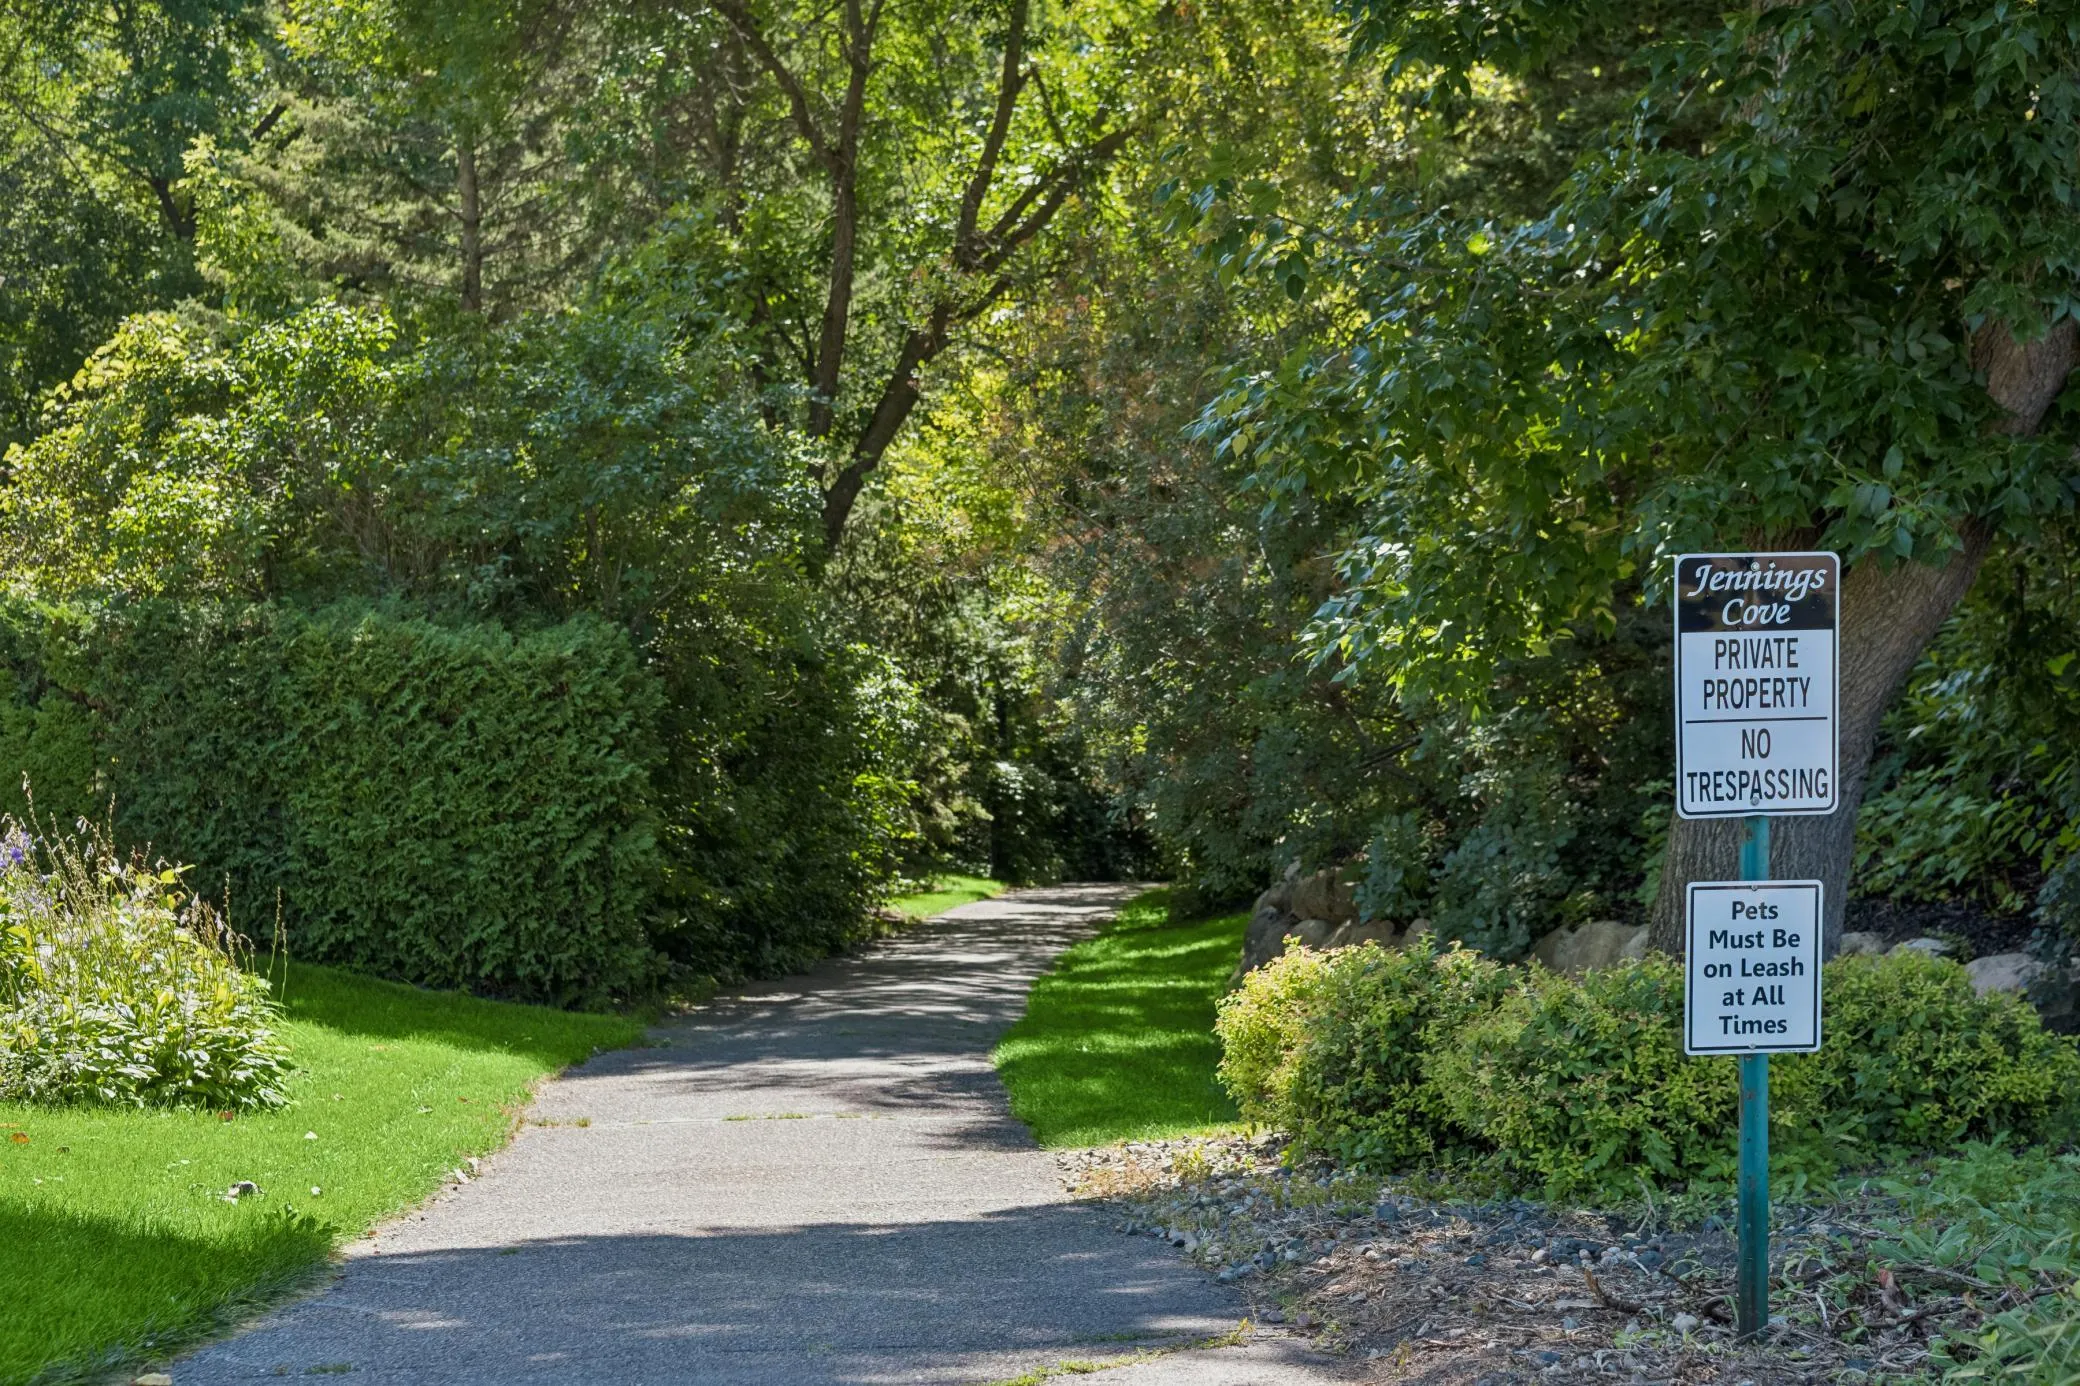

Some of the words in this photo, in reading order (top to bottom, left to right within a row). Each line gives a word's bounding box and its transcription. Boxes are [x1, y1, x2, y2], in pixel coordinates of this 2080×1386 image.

[1686, 561, 1829, 602] Jennings
[1721, 598, 1791, 626] Cove
[1714, 637, 1799, 670] PRIVATE
[1703, 676, 1811, 711] PROPERTY
[1741, 727, 1771, 760] NO
[1686, 767, 1829, 803] TRESPASSING
[1731, 900, 1779, 921] Pets
[1709, 929, 1765, 950] Must
[1772, 928, 1801, 948] Be
[1703, 962, 1732, 979] on
[1741, 956, 1804, 978] Leash
[1722, 988, 1745, 1007] at
[1751, 984, 1786, 1006] All
[1718, 1014, 1788, 1035] Times
